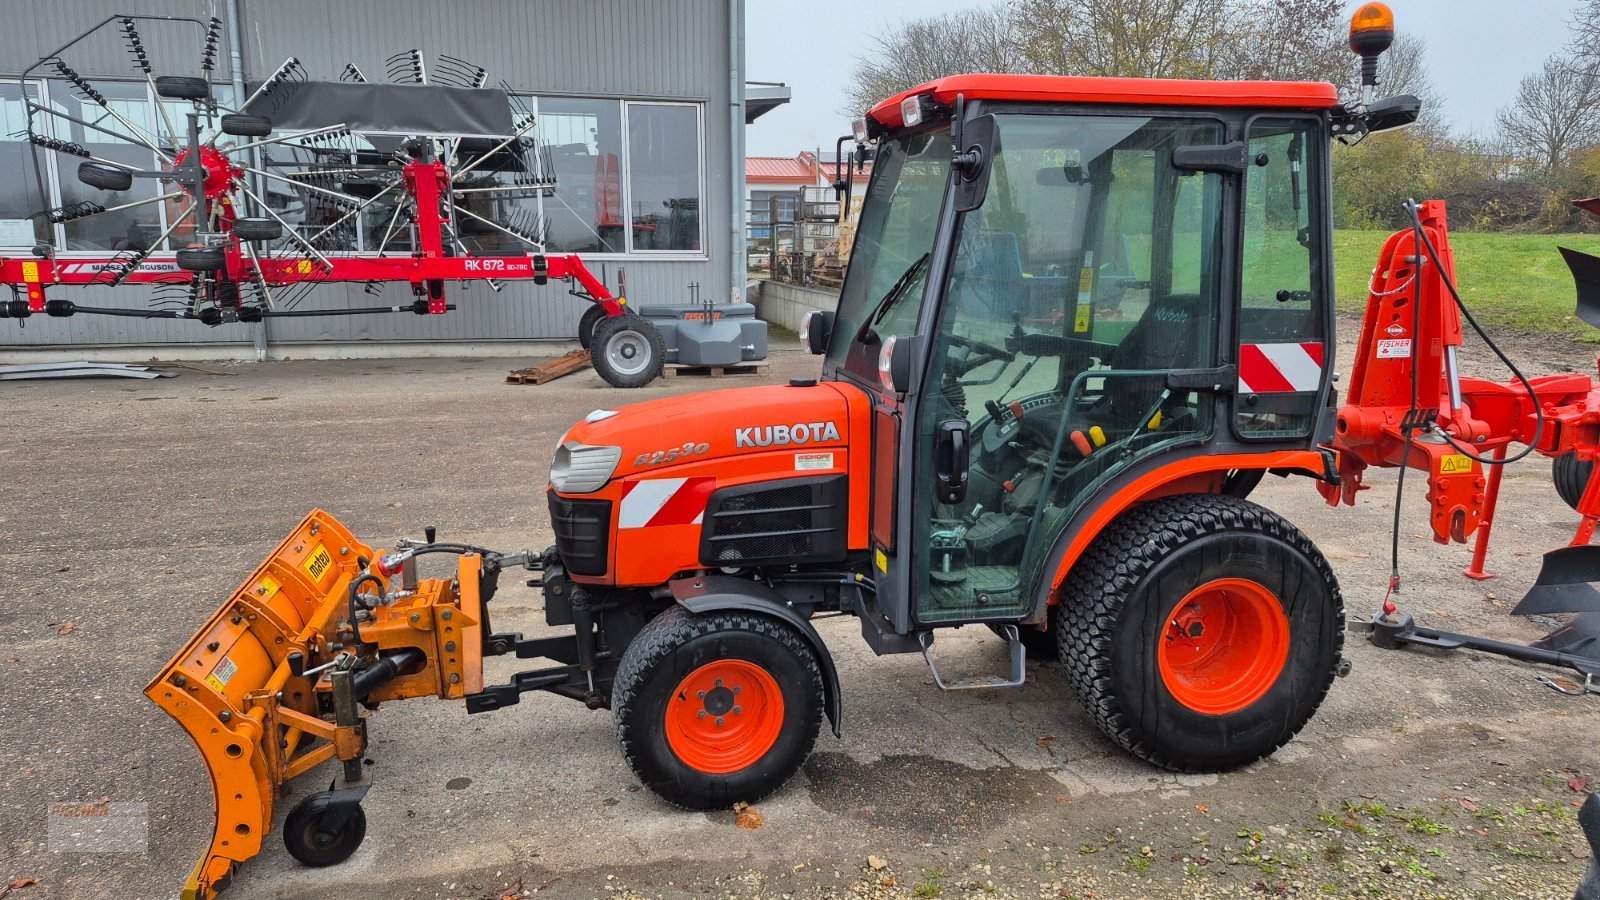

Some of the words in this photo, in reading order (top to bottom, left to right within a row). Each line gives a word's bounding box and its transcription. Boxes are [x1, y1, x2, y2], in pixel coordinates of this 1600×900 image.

[464, 259, 481, 270] RK
[483, 259, 504, 270] 672
[684, 312, 721, 320] FISCR
[1379, 340, 1410, 348] FISCHER
[735, 421, 841, 449] KUBOTA
[633, 442, 710, 467] B2530
